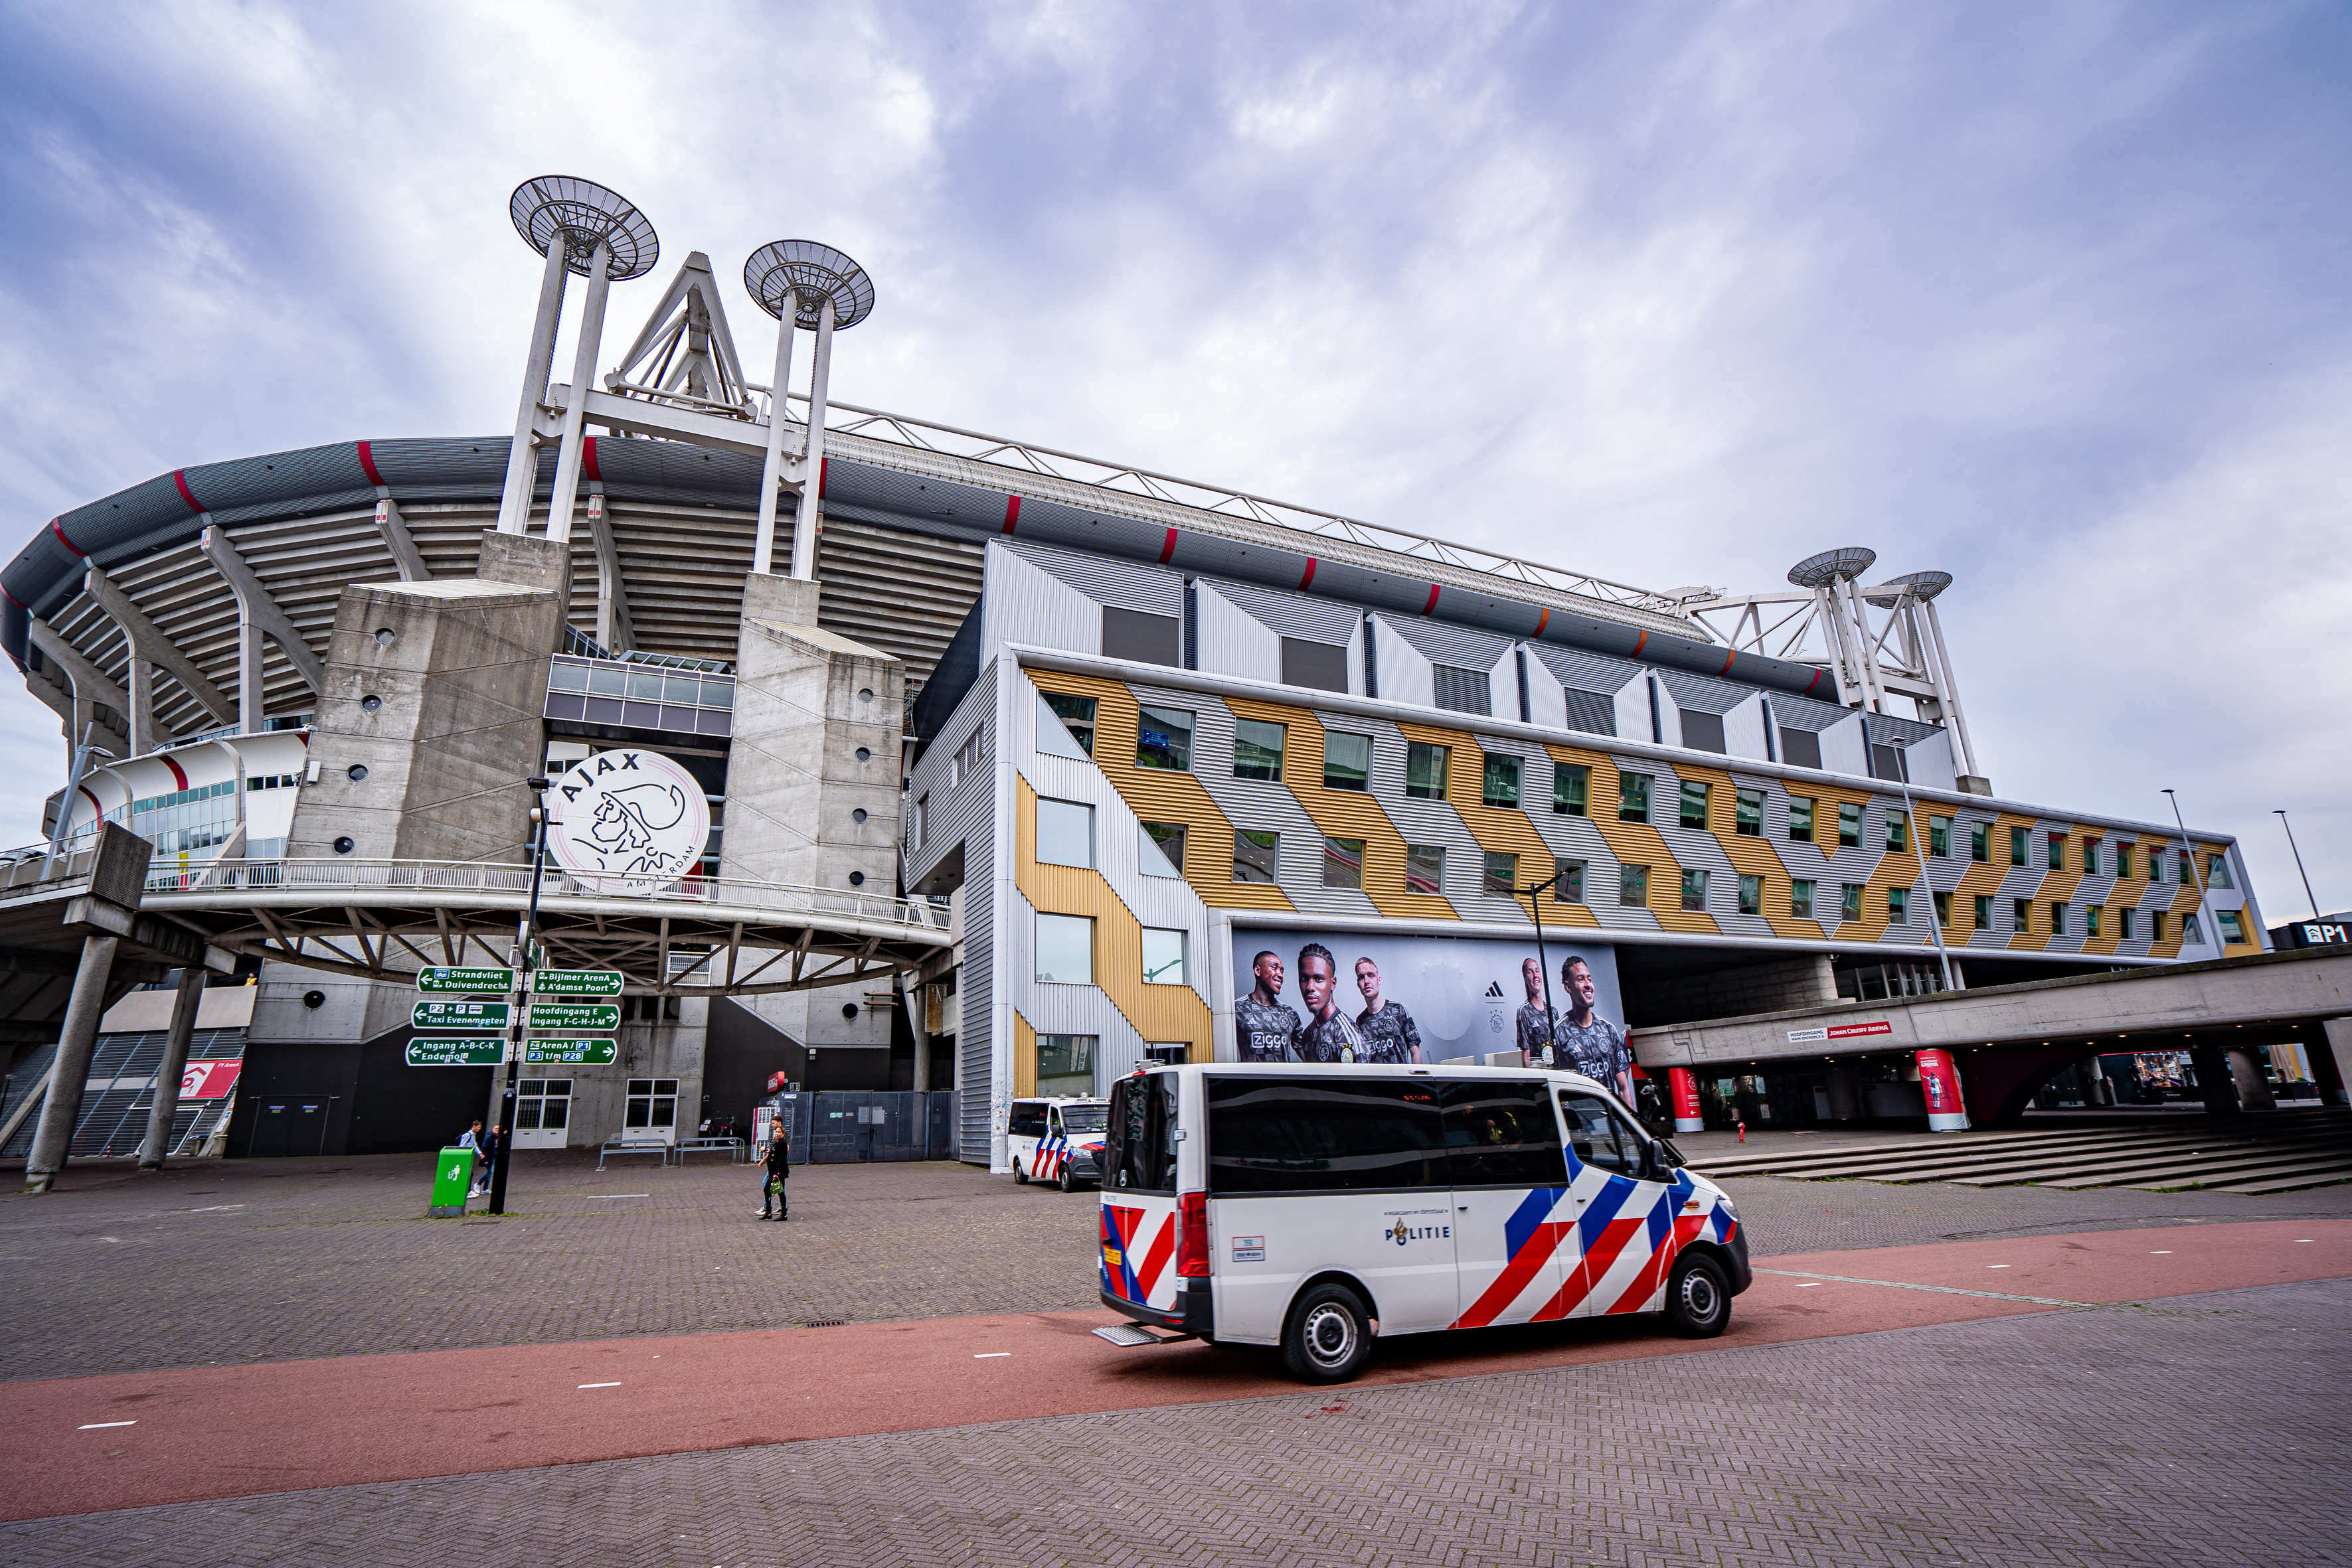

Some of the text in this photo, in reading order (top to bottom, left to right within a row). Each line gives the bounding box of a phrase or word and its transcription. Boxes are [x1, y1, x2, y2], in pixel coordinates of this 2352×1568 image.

[560, 753, 639, 803] AJAX
[2321, 925, 2349, 943] P1
[451, 971, 503, 979] Strandvliet
[548, 973, 582, 982] Bijlmer
[533, 1007, 590, 1016] Hoofdingang
[532, 1017, 562, 1026] Ingang
[422, 1042, 456, 1051] Ingang
[1385, 1226, 1450, 1246] POLITIE
